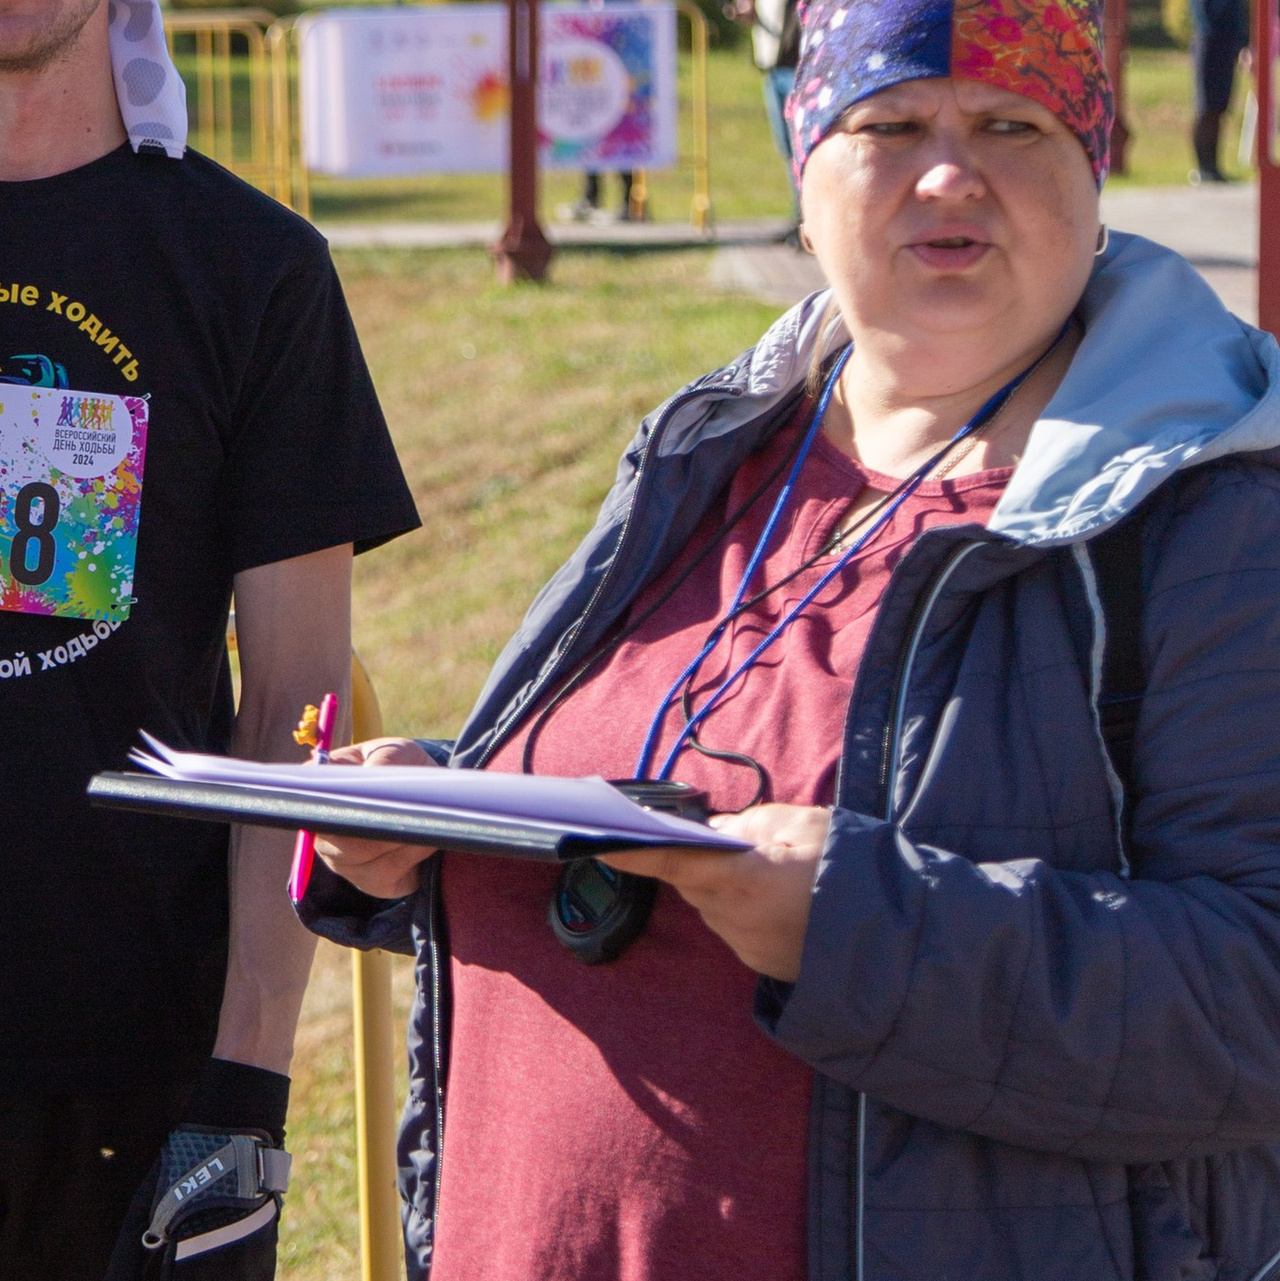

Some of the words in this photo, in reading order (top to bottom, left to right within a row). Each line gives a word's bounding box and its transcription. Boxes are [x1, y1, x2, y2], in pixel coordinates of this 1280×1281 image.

[46, 291, 139, 382] ходить
[55, 429, 116, 443] ВСЕРОССИЙСКИЙ
[53, 439, 77, 451] ДЕНЬ
[79, 442, 115, 455] ХОДЬБЫ
[72, 454, 94, 466] 2024
[173, 1157, 224, 1201] LEKI
